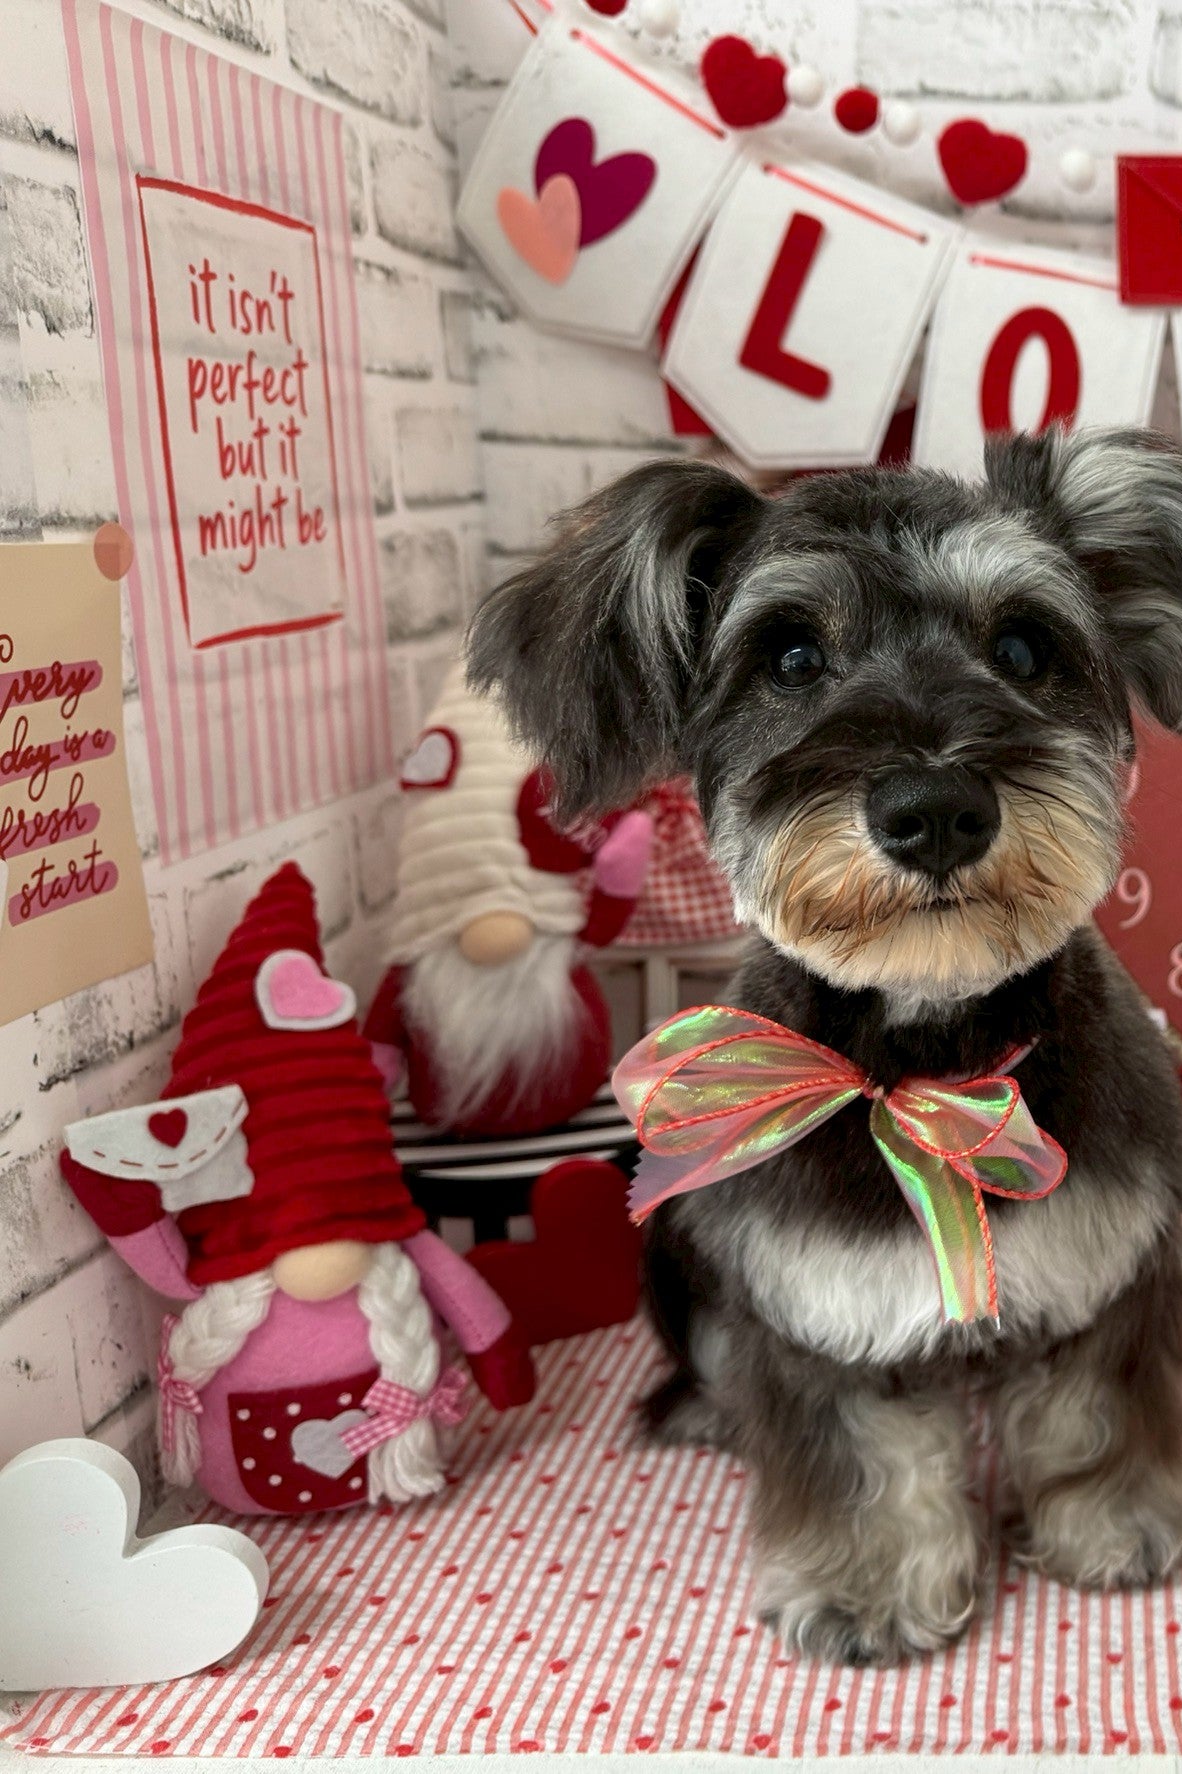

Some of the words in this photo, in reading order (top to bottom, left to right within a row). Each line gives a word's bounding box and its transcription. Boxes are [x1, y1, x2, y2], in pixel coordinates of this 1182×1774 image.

[189, 258, 217, 333] it
[229, 270, 295, 344] isn't
[188, 350, 310, 433] perfect
[217, 417, 271, 481] but
[279, 417, 302, 481] it
[198, 485, 288, 573] might
[297, 483, 327, 544] be
[0, 634, 95, 720] very
[0, 716, 60, 802] day
[63, 725, 88, 762] is
[92, 729, 110, 749] a
[20, 839, 109, 919] start
[1116, 867, 1152, 930] 9
